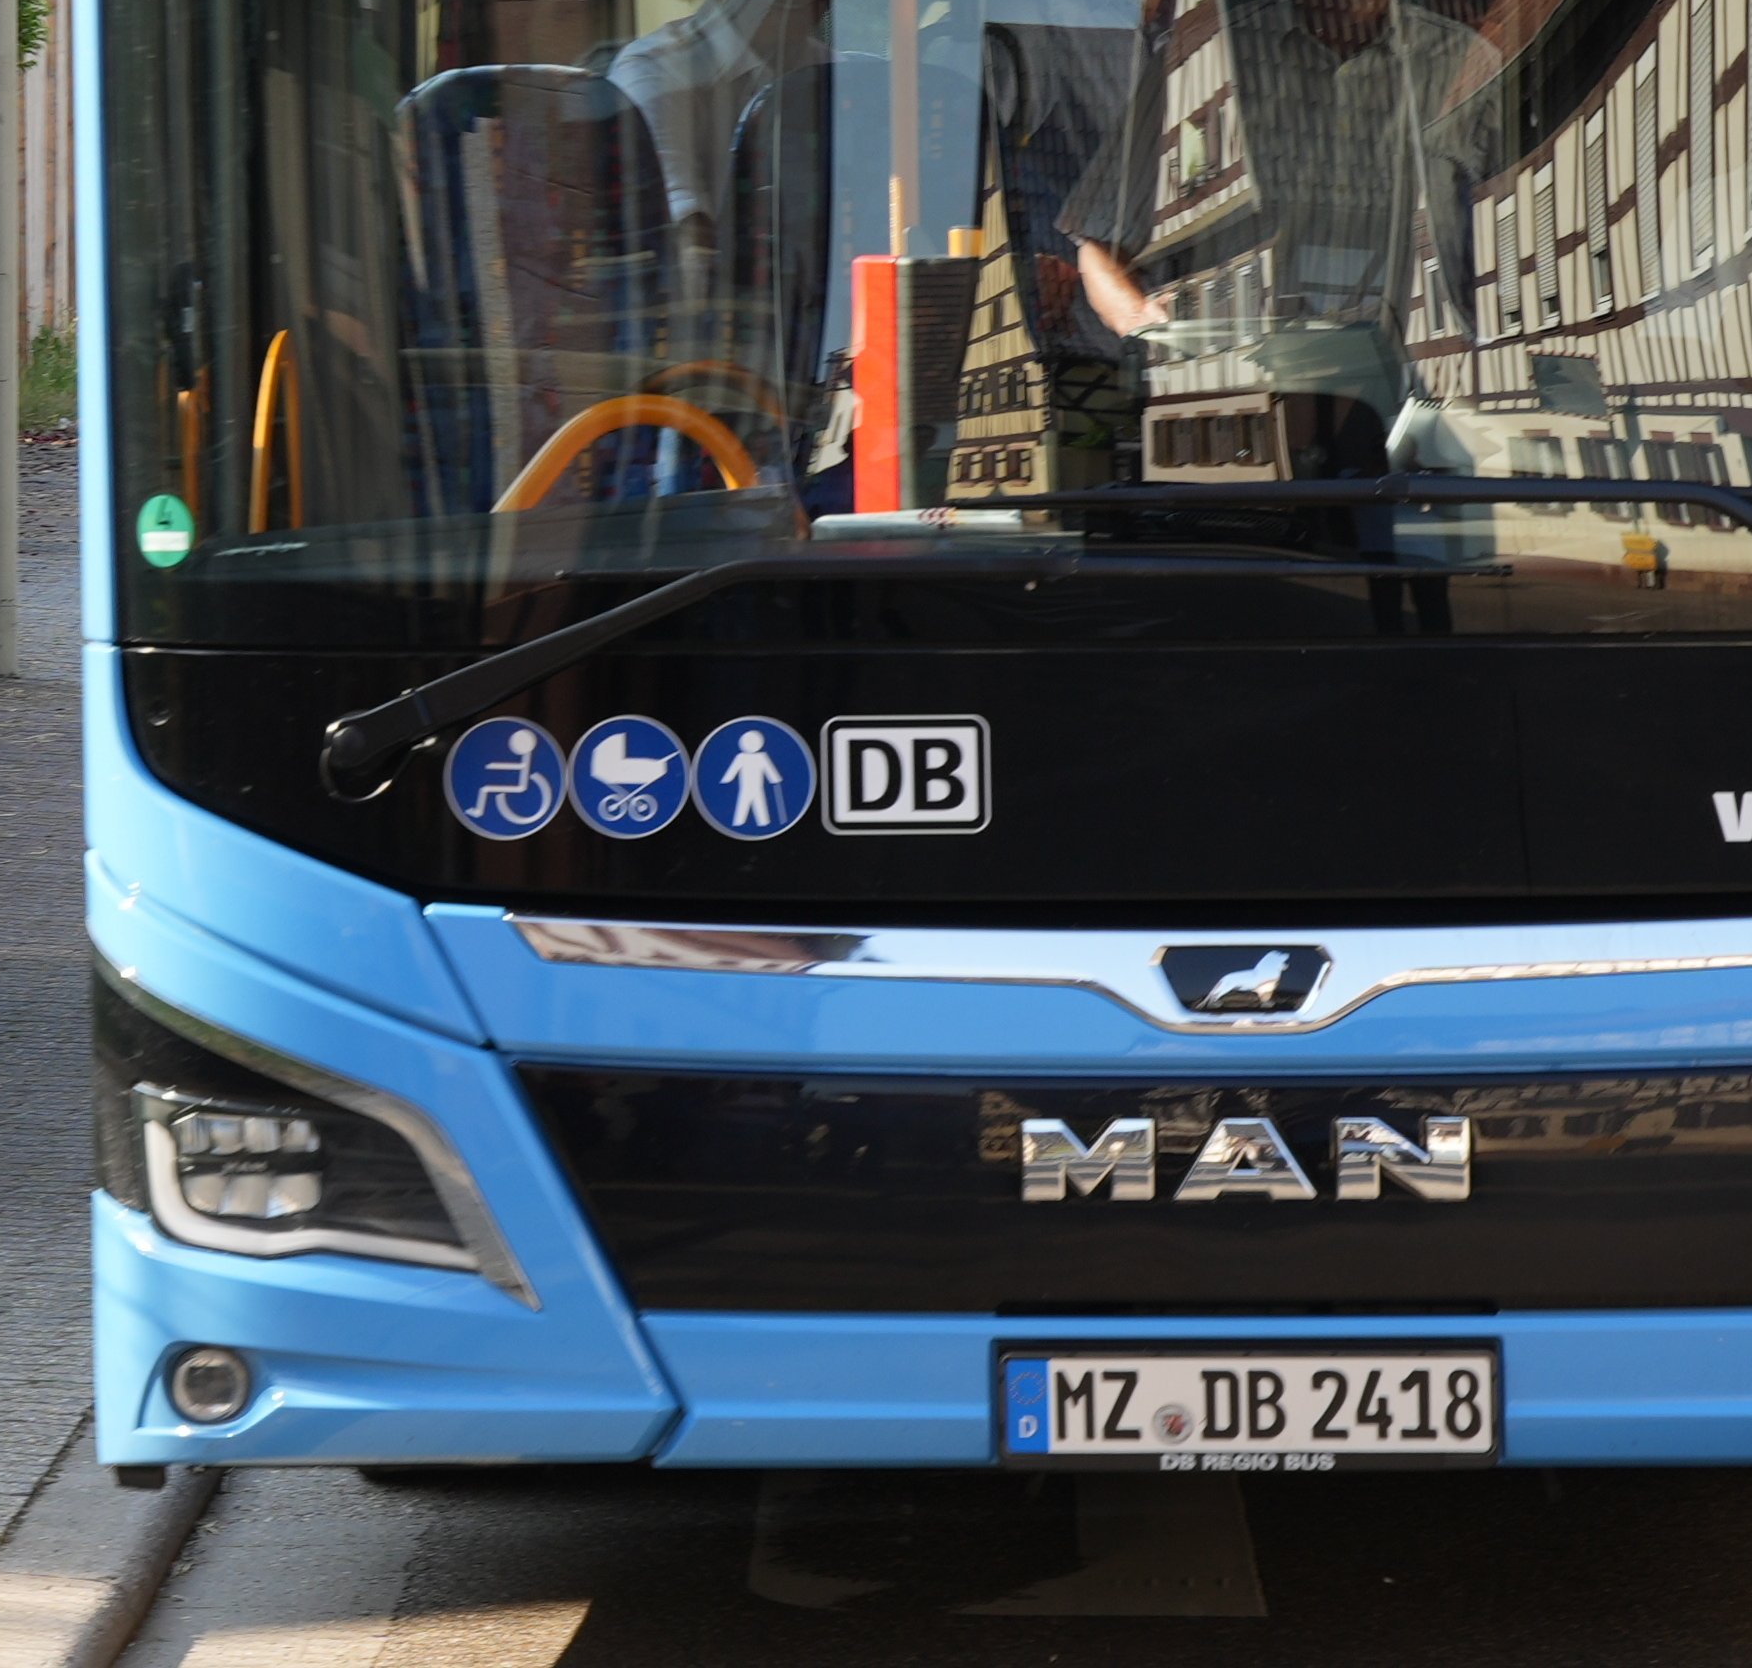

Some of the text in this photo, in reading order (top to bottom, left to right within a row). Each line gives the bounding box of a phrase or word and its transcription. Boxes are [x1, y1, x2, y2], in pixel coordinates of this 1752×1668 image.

[847, 737, 966, 812] DB
[1020, 1116, 1472, 1202] MAN
[1018, 1414, 1039, 1439] D
[1055, 1368, 1483, 1441] MZ DB 2418
[1160, 1453, 1336, 1471] DB REGIO BUS
